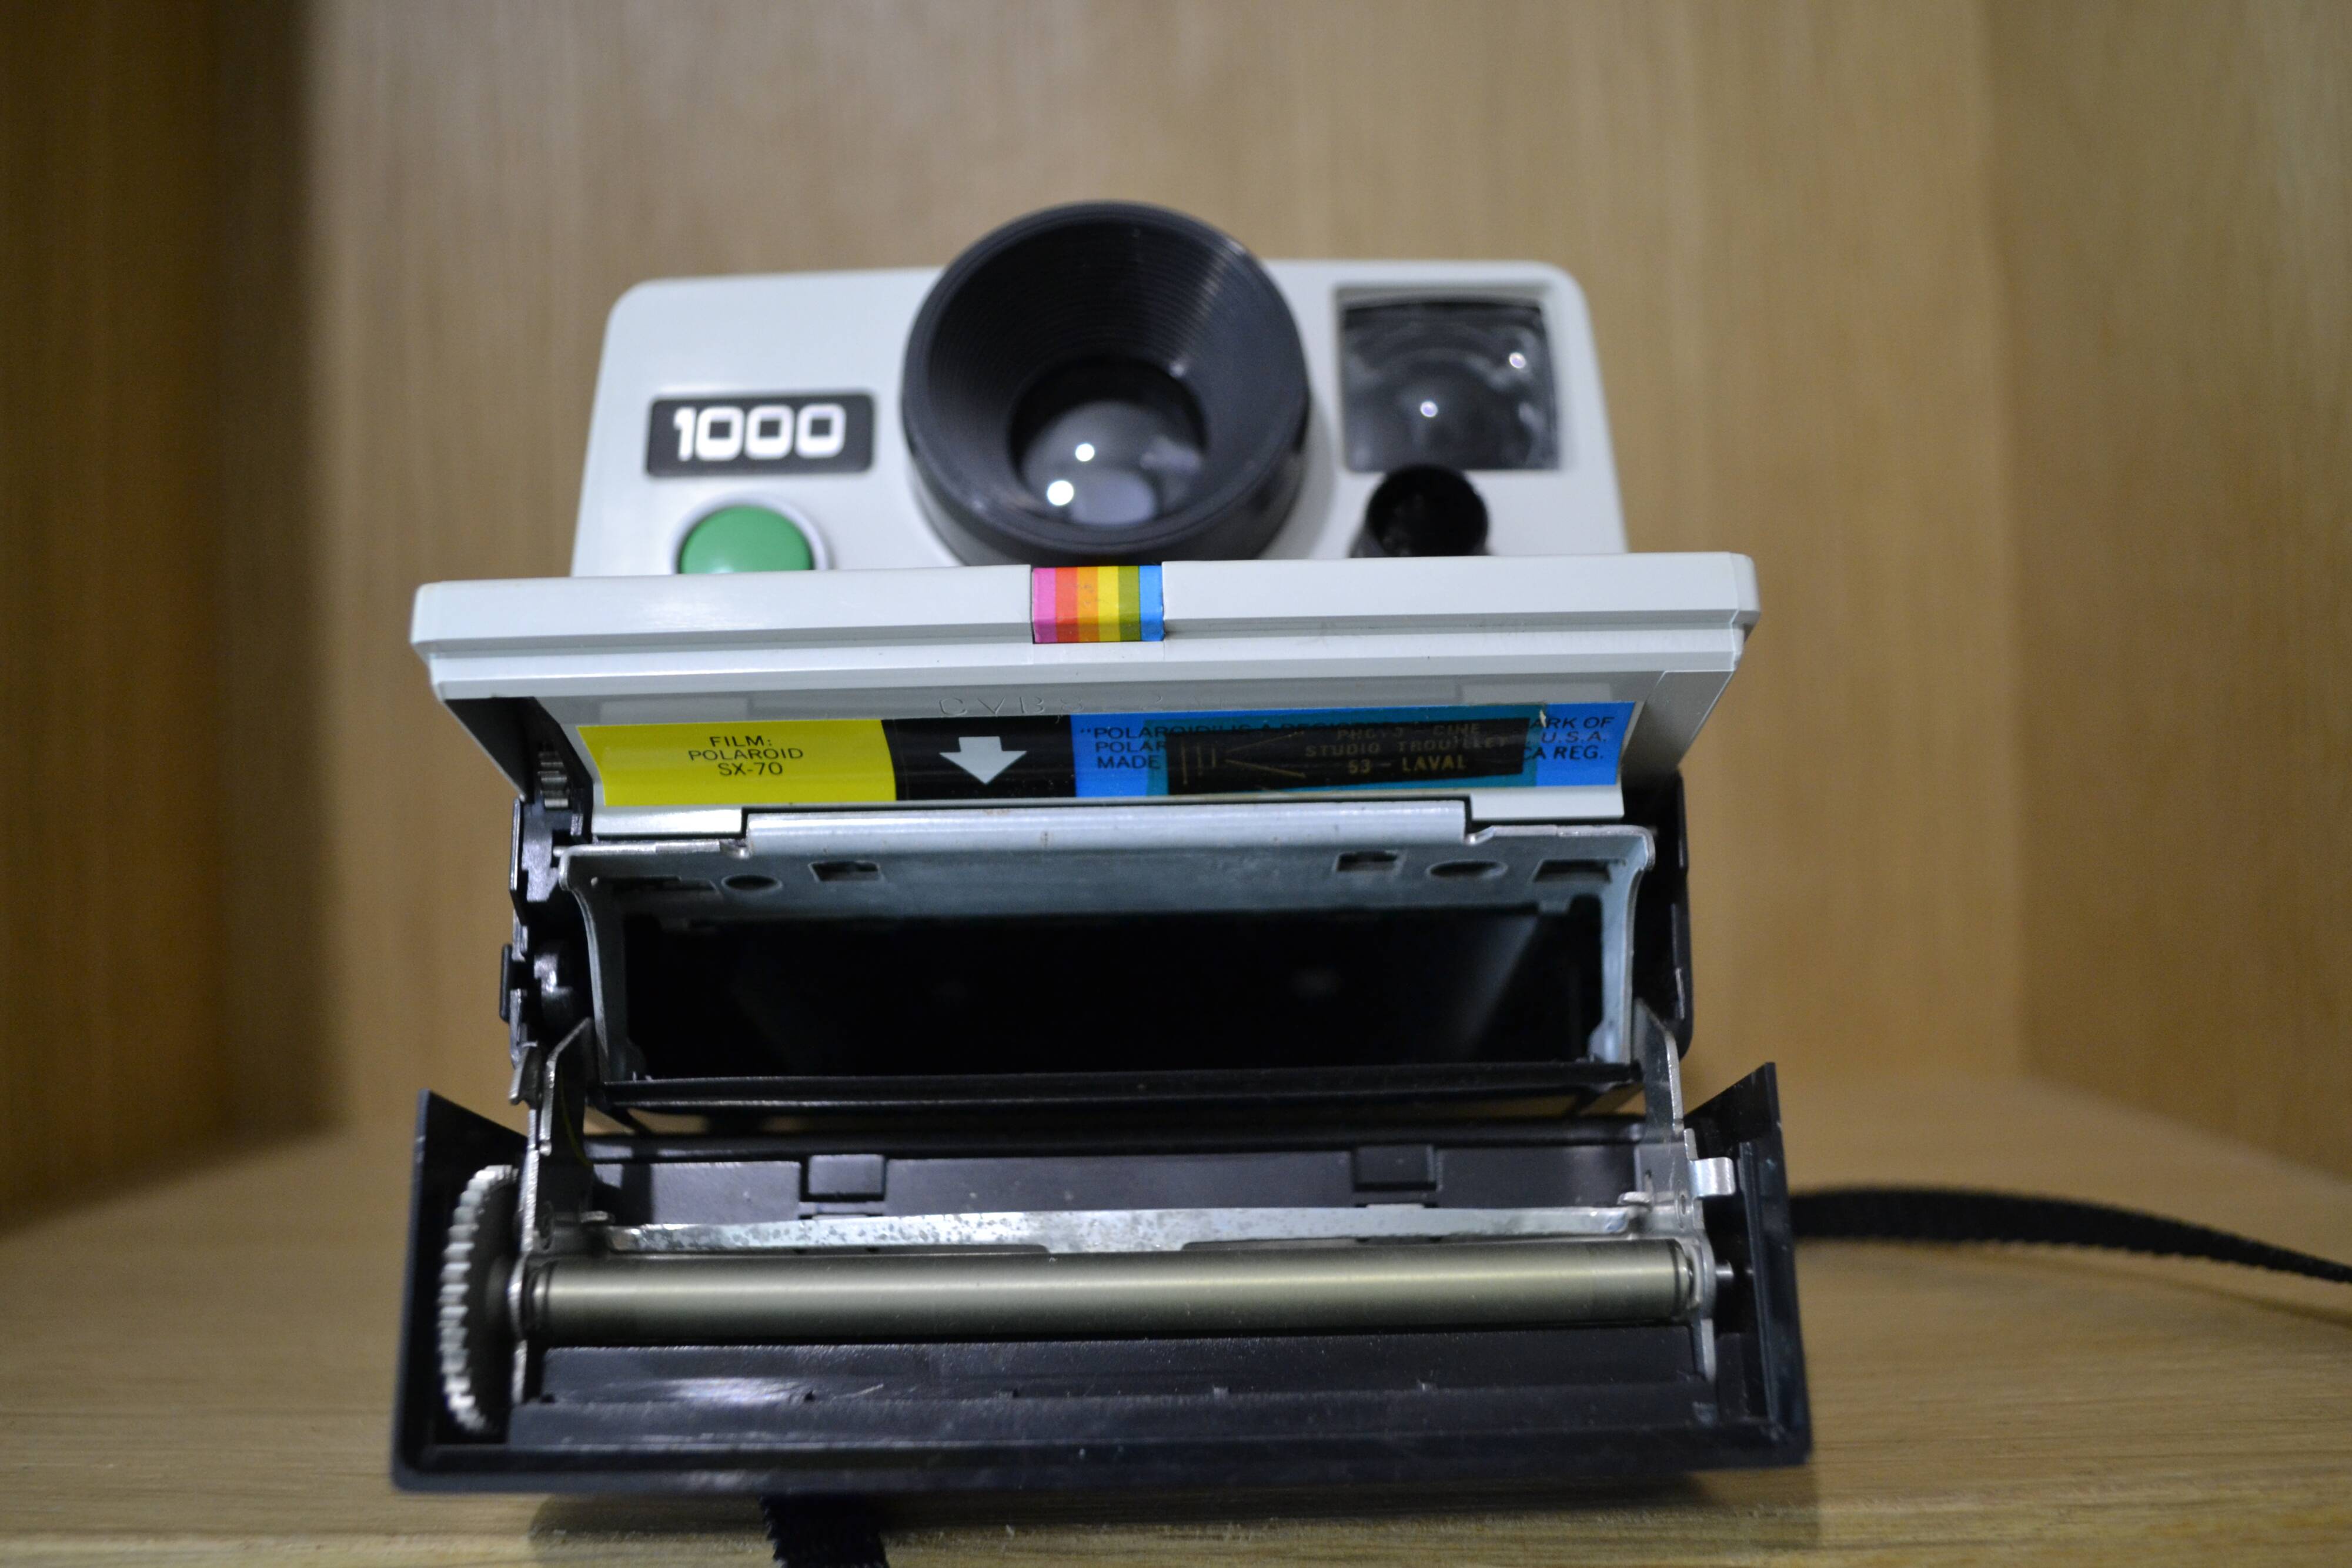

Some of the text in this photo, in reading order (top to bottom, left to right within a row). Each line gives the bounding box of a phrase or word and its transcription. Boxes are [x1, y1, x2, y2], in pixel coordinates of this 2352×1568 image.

[673, 403, 846, 462] 1000
[1583, 716, 1615, 729] OF
[709, 735, 772, 747] FILM:
[1541, 731, 1607, 744] U.S.A.
[688, 748, 803, 761] POLAROID
[1305, 742, 1381, 757] STUDIO
[1097, 755, 1161, 770] MADE
[1553, 745, 1604, 760] REG.
[1401, 754, 1468, 772] LAVAL
[717, 761, 783, 776] SX-70
